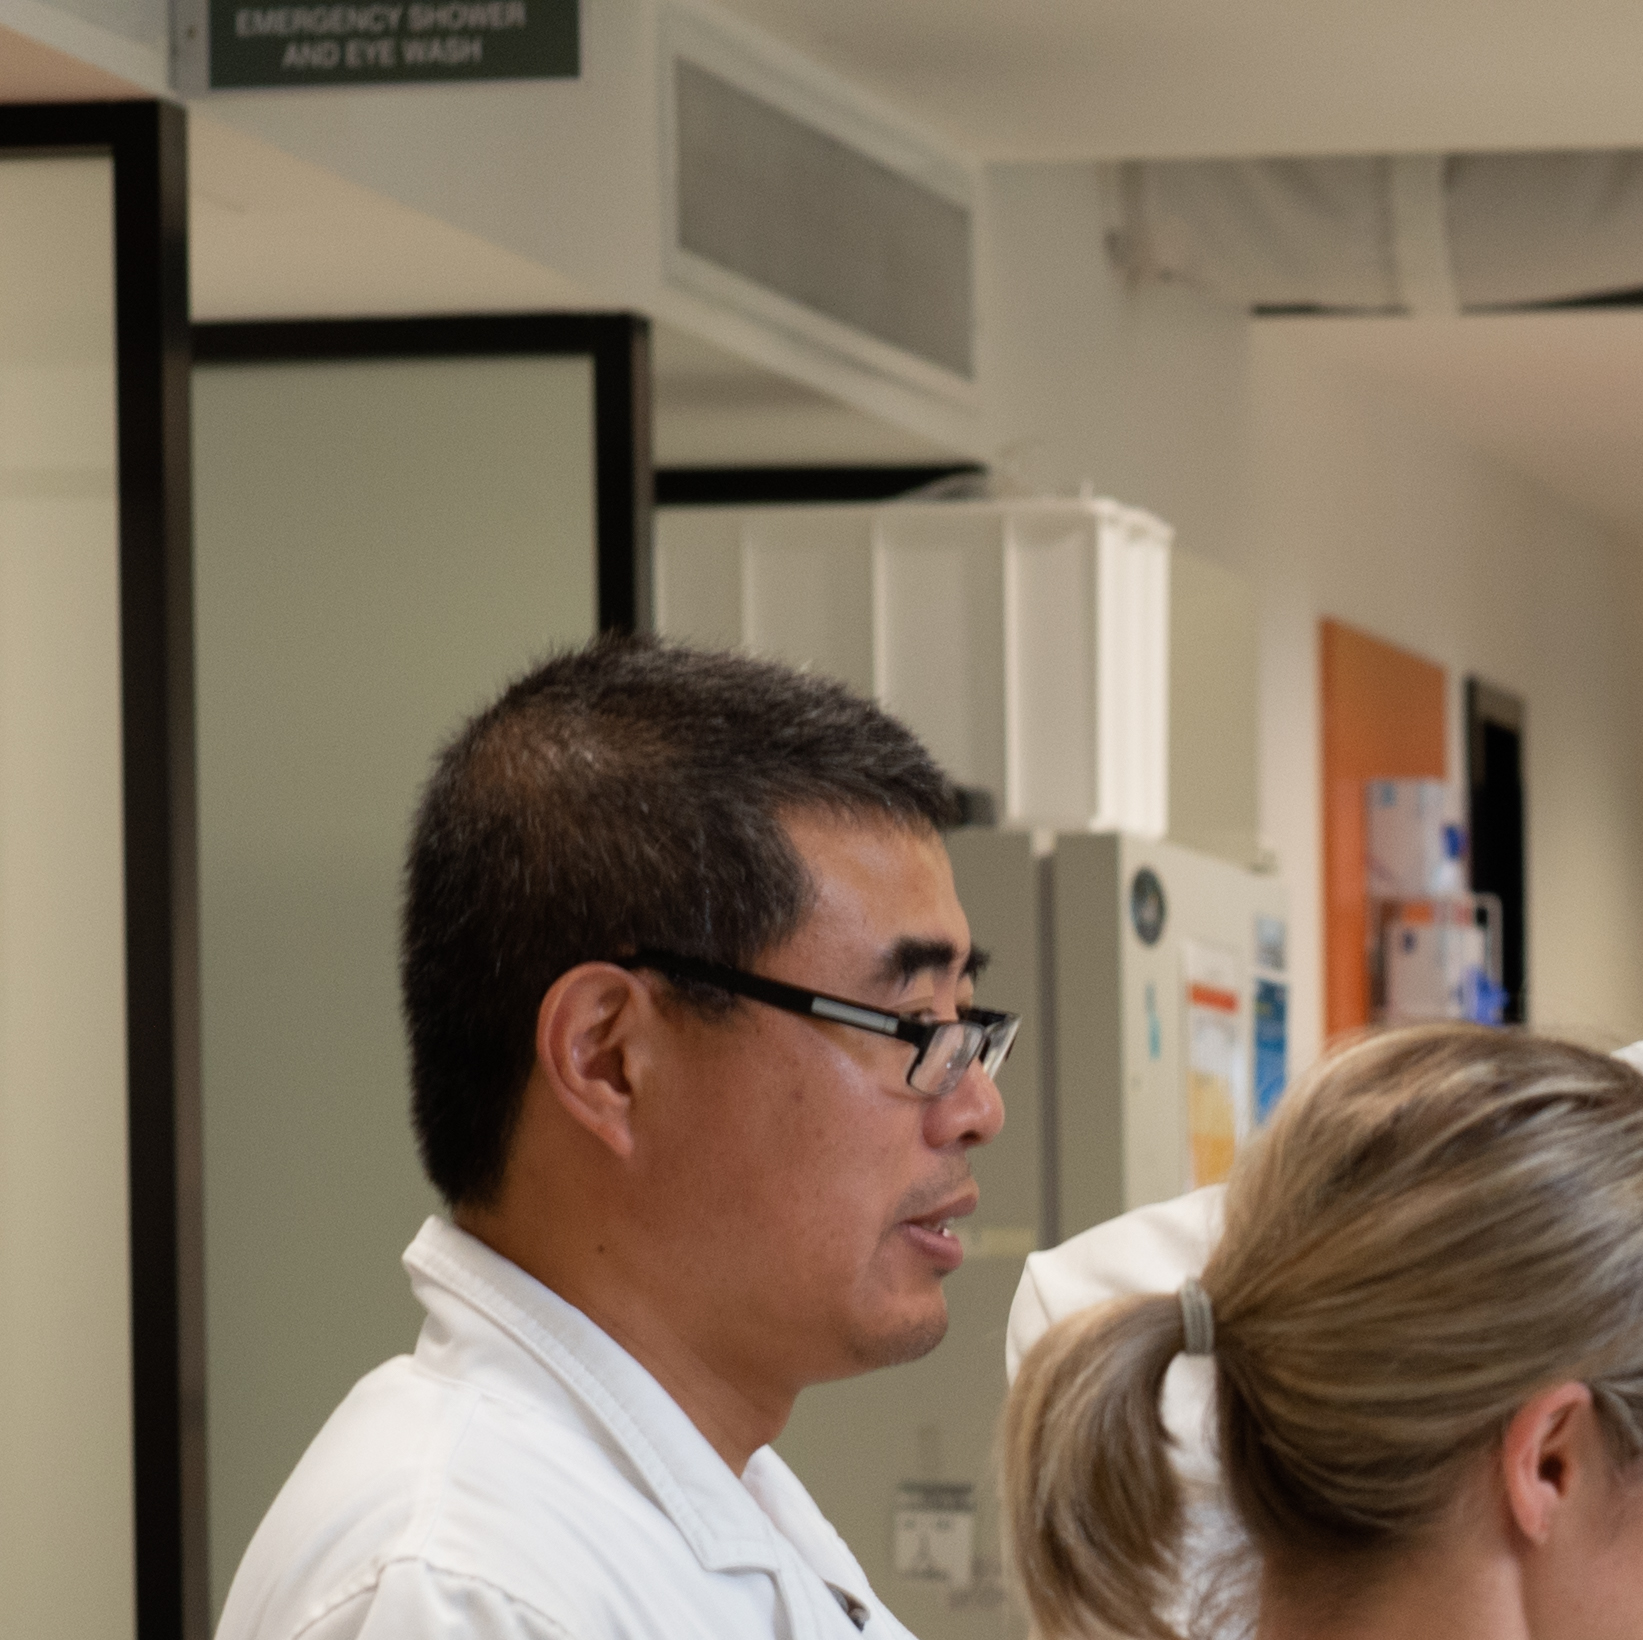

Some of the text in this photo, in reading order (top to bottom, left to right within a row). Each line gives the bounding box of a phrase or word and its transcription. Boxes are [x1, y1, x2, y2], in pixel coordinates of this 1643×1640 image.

[235, 1, 526, 37] EMERGENCY SHOWER
[282, 35, 483, 69] AND EYE WASH
